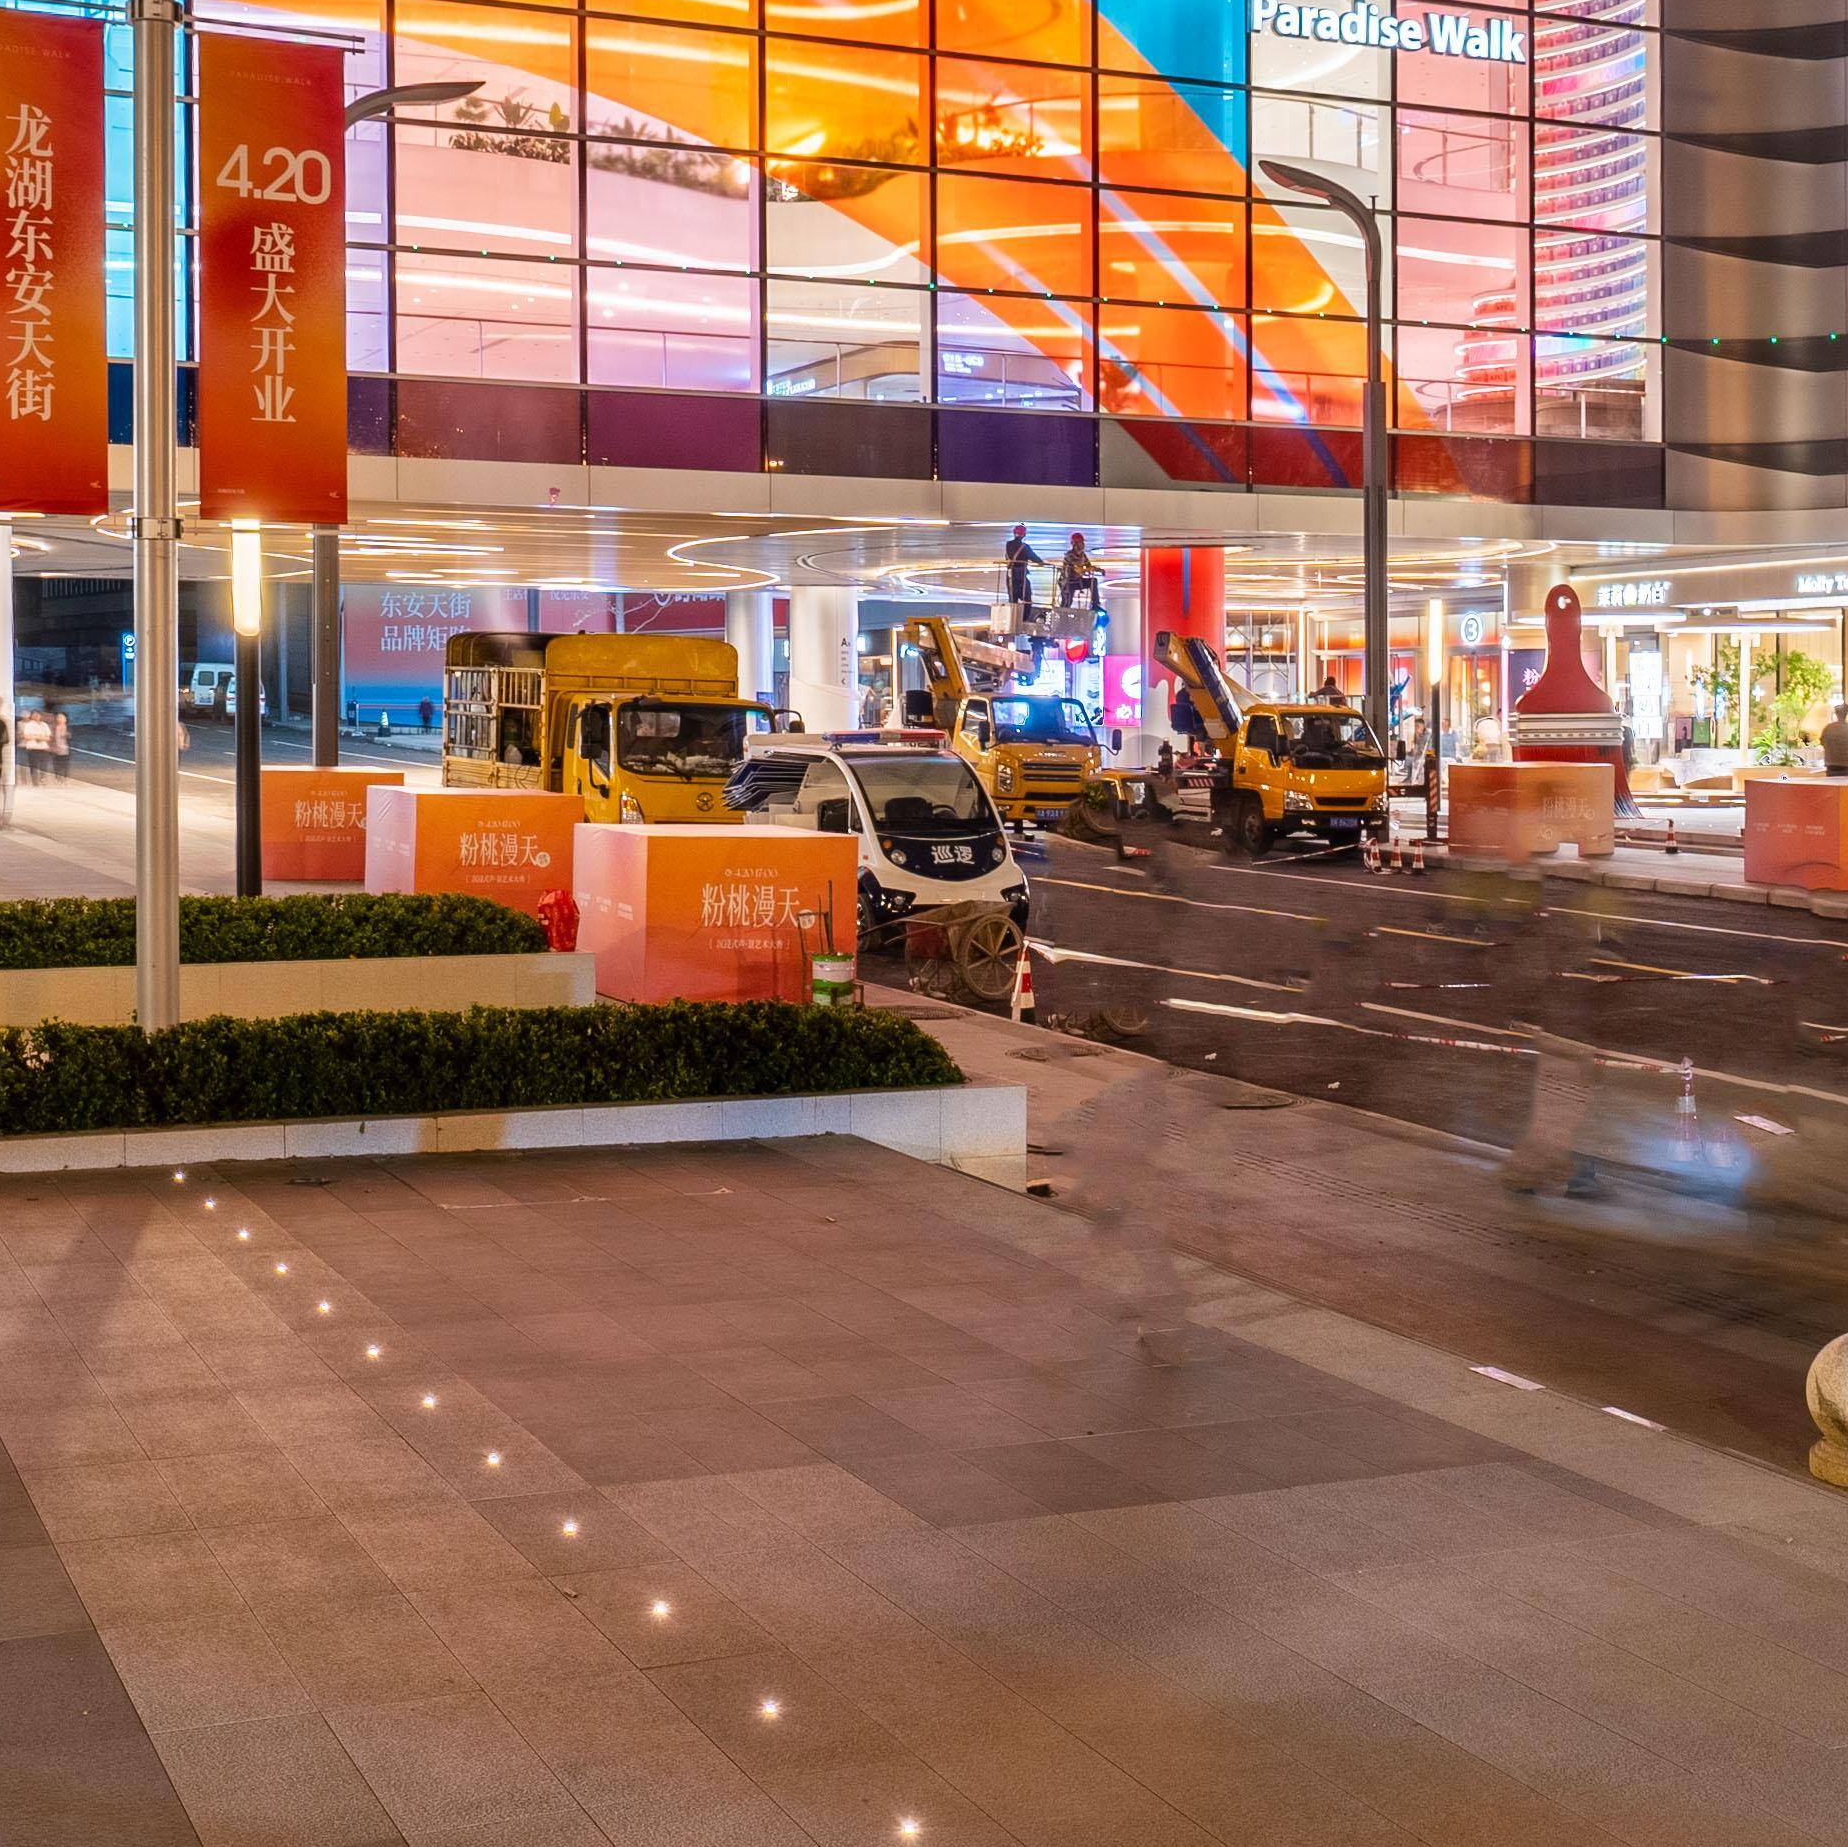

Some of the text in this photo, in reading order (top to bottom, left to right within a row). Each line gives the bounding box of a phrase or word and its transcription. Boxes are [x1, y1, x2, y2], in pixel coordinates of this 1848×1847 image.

[40, 47, 72, 60] WALK
[1426, 12, 1527, 64] Walk
[216, 143, 332, 205] 4.20
[5, 103, 54, 422] 龙湖东安天街
[250, 222, 296, 424] 盛大开业
[379, 591, 472, 619] 东安天街
[294, 799, 363, 830] 粉桃漫天
[459, 832, 540, 868] 粉桃漫天
[931, 845, 975, 865] 巡逻
[701, 883, 801, 929] 粉桃漫天
